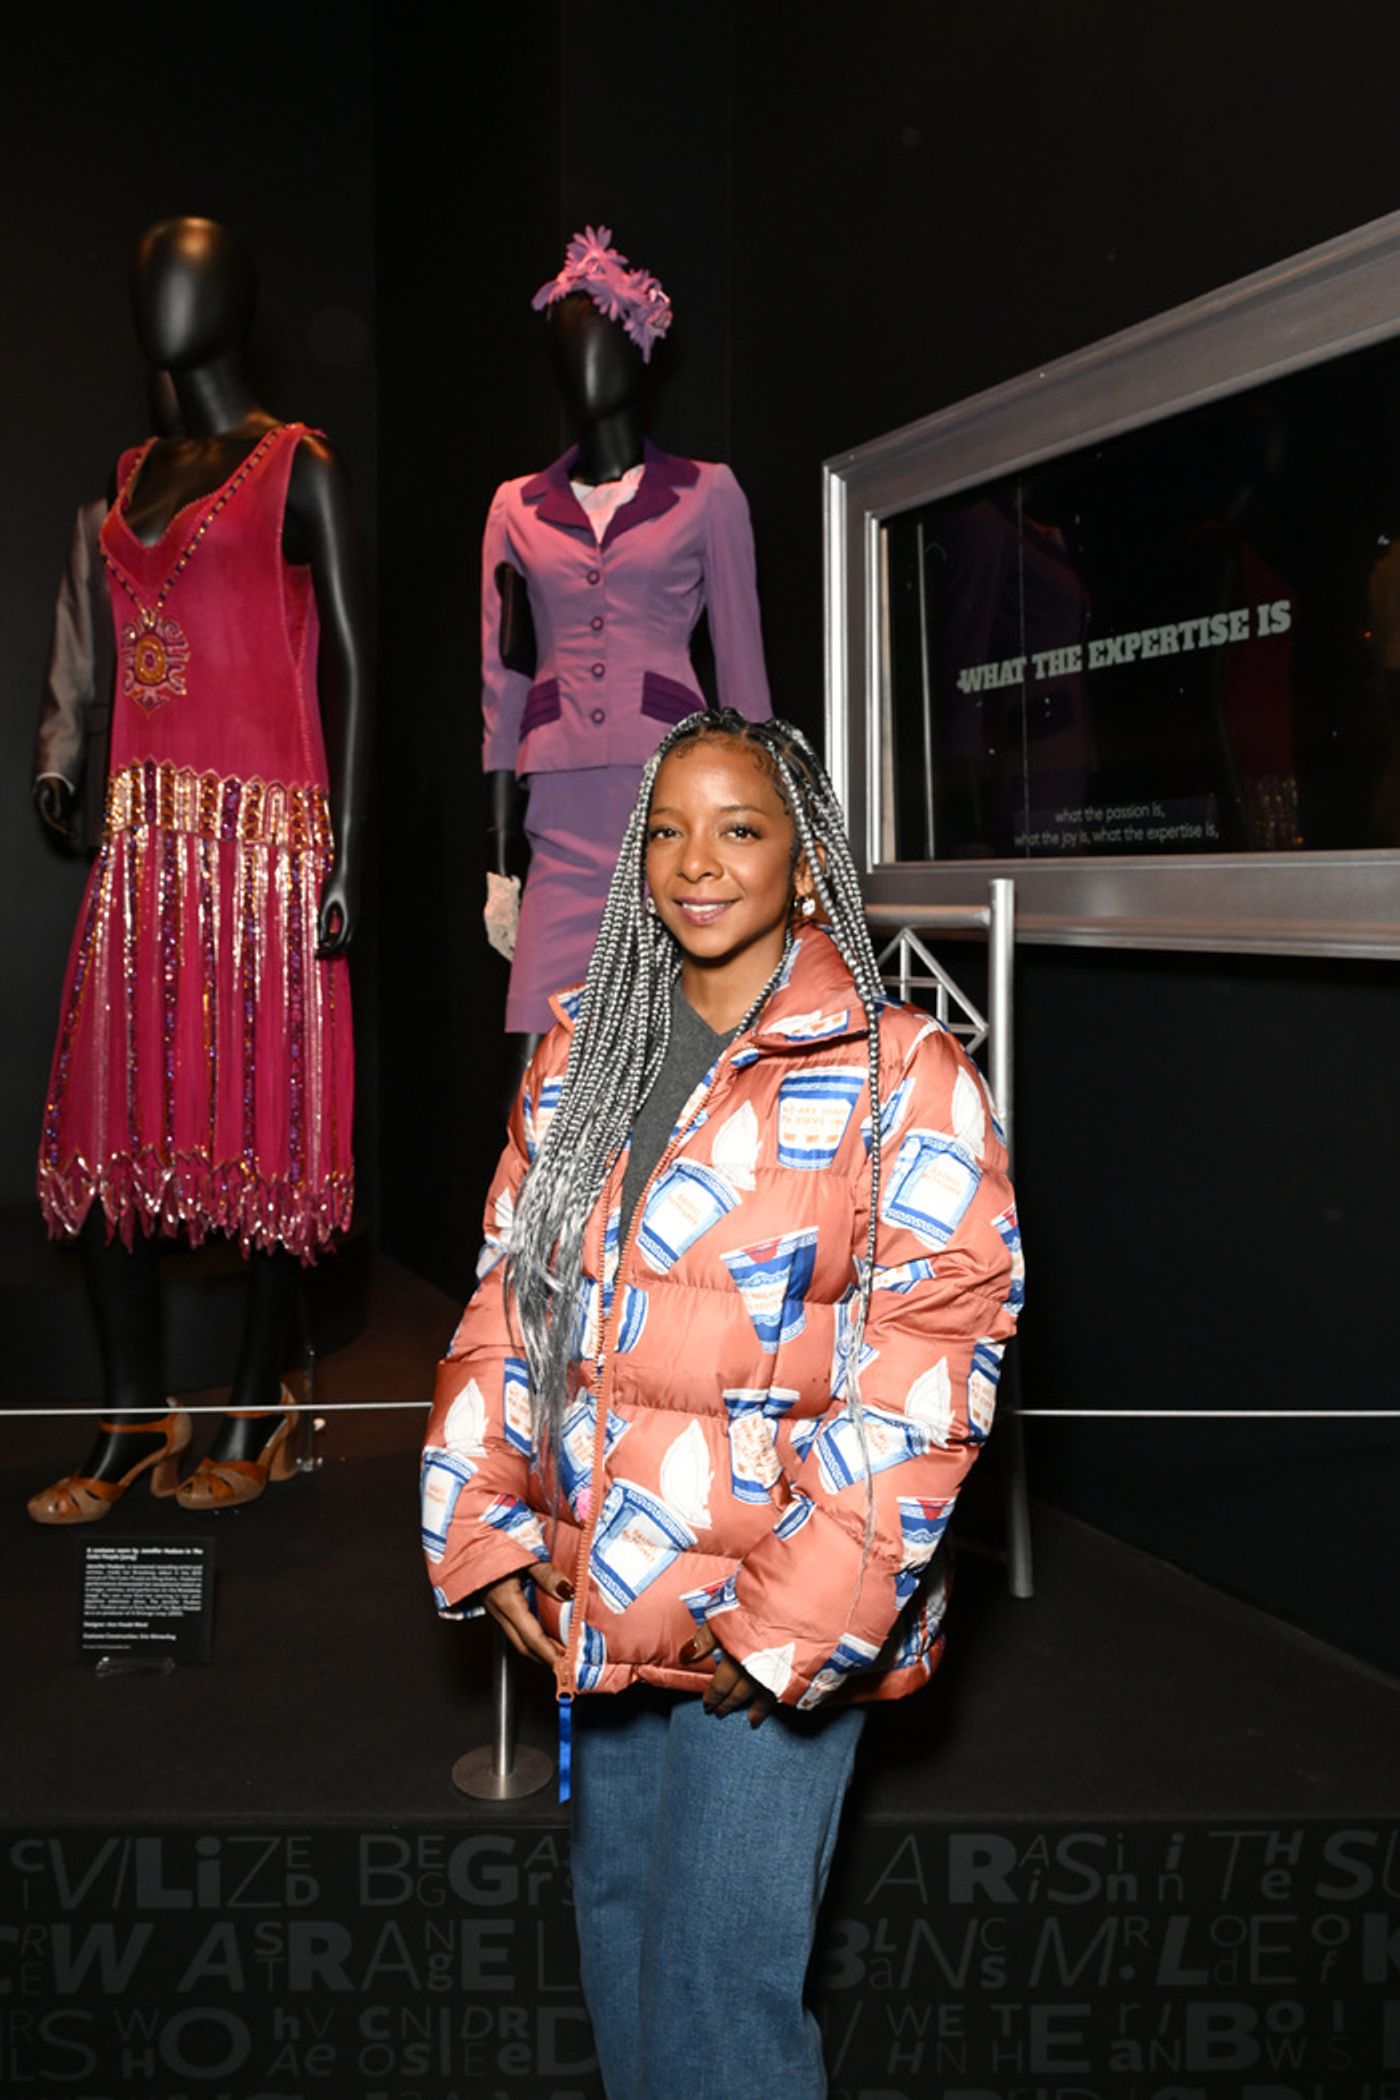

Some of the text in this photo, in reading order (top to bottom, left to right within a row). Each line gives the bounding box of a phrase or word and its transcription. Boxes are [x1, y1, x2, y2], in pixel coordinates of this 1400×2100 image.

[957, 599, 1292, 694] WHAT THE EXPERTISE IS
[1055, 808, 1083, 823] what
[1084, 806, 1104, 822] the
[1105, 803, 1150, 824] passion
[1014, 832, 1040, 847] what
[1042, 830, 1060, 846] the
[1093, 826, 1122, 842] what
[1123, 823, 1144, 841] the
[1146, 821, 1203, 844] expertise
